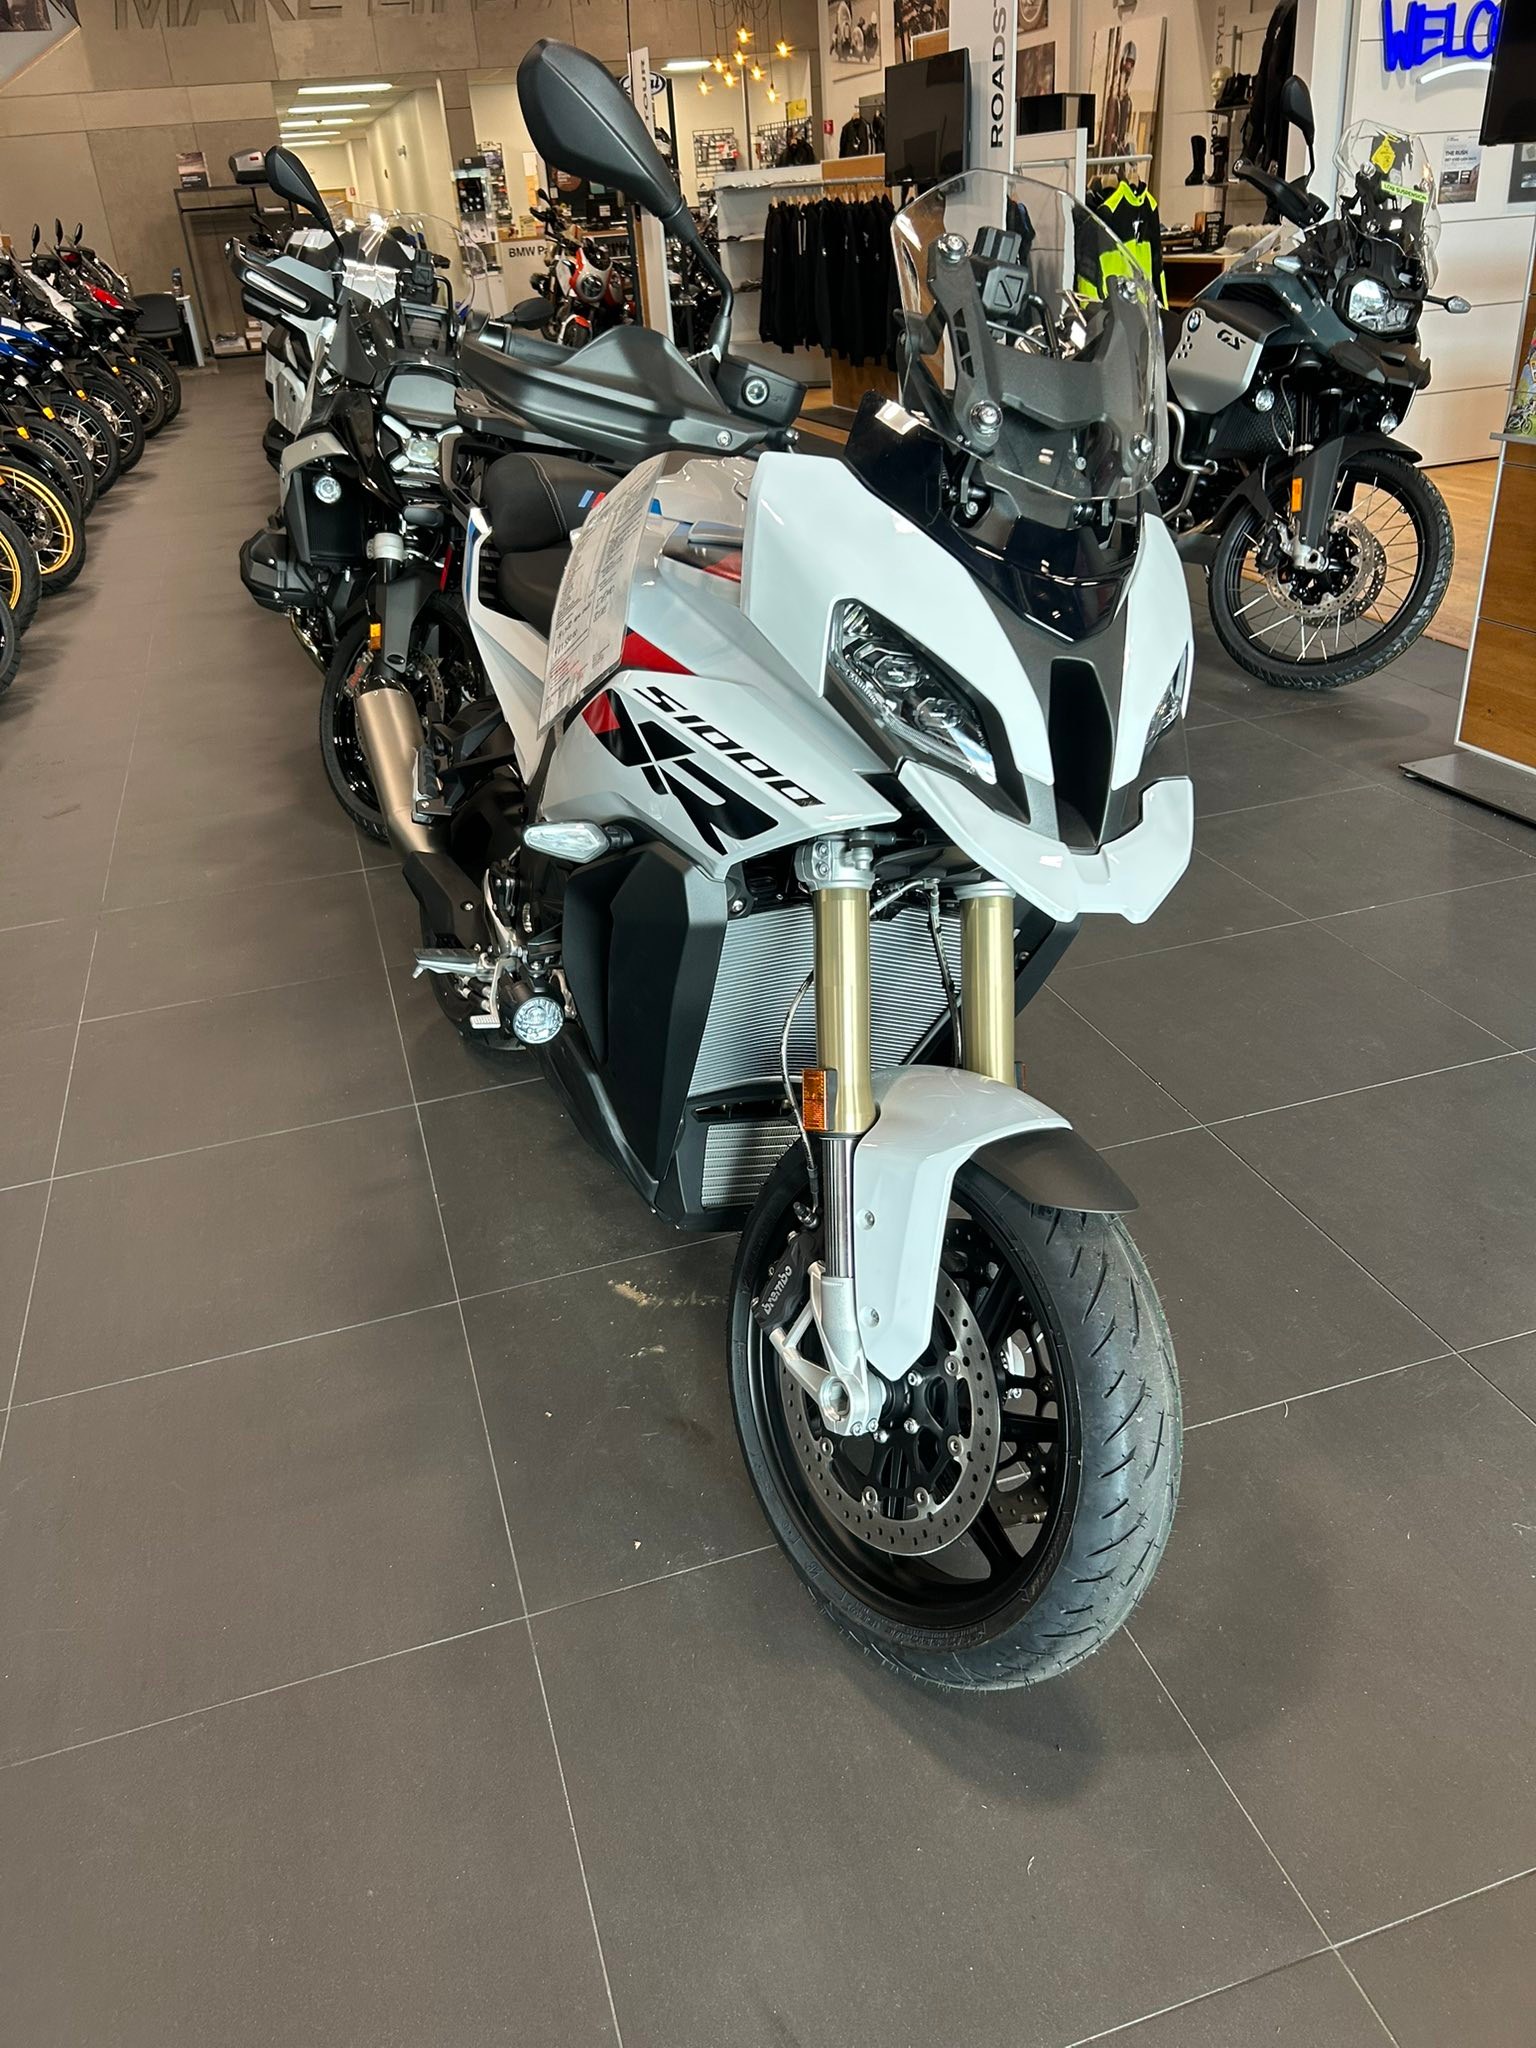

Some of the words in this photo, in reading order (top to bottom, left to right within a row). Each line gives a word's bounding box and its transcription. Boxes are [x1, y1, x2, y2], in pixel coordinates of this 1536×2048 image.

[1215, 6, 1226, 65] STYLE
[509, 246, 535, 257] BMW
[1217, 329, 1246, 350] GS
[633, 686, 826, 807] S1000
[761, 1265, 793, 1315] brembo
